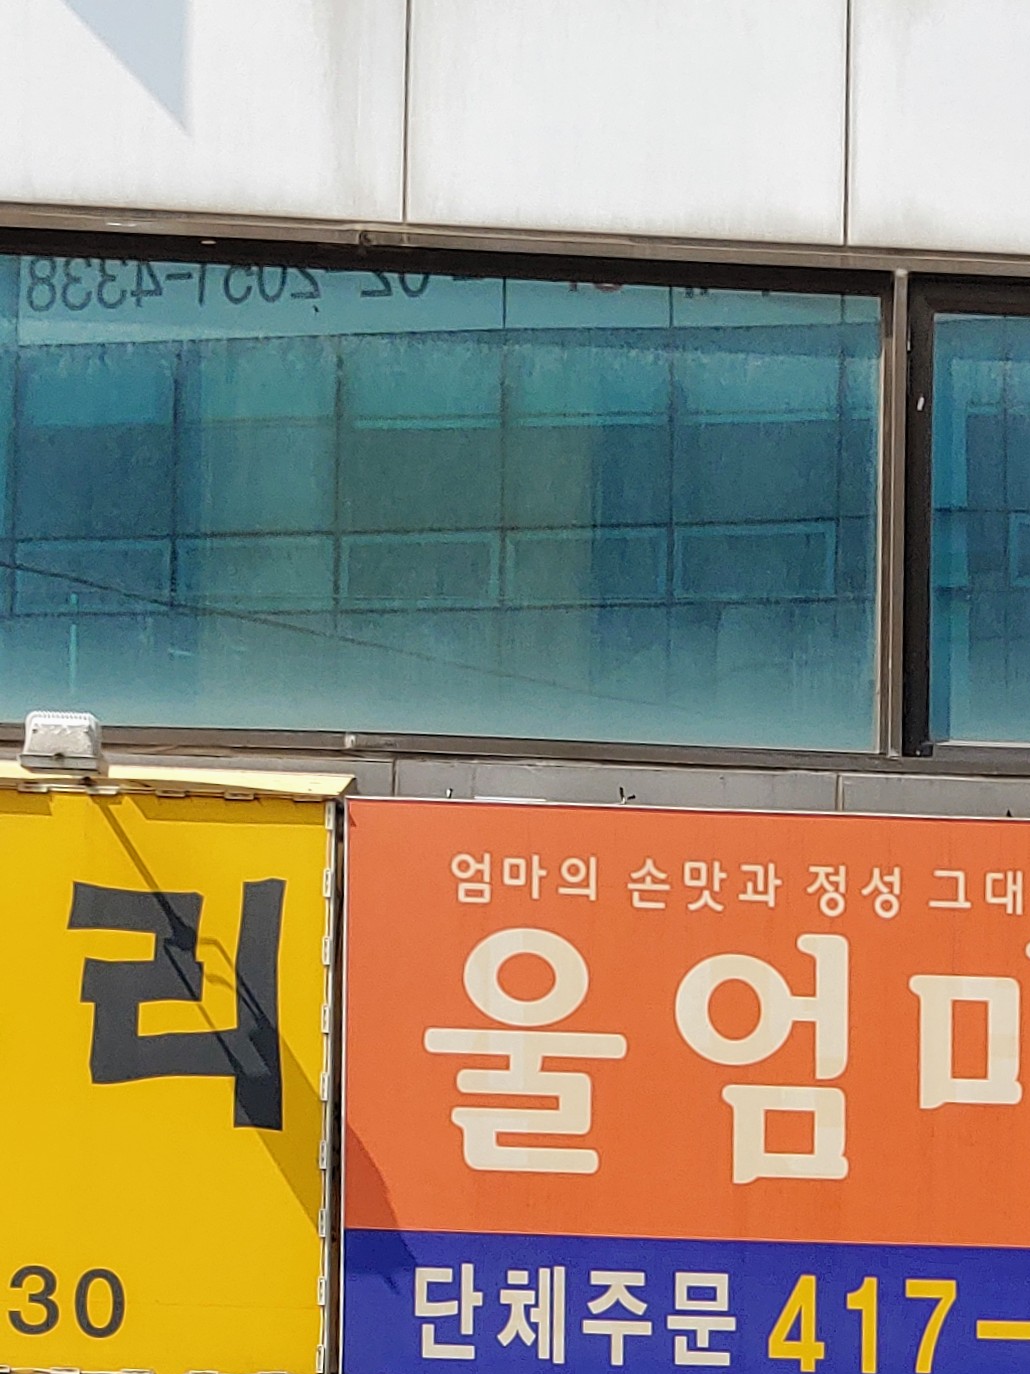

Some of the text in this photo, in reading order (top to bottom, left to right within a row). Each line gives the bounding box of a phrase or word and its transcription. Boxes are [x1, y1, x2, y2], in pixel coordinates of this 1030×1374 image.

[450, 851, 599, 902] 엄마의
[626, 857, 783, 911] 손맛과
[806, 862, 902, 919] 정성
[67, 877, 286, 1131] 리
[8, 1265, 126, 1339] 30
[413, 1262, 737, 1367] 단체주문
